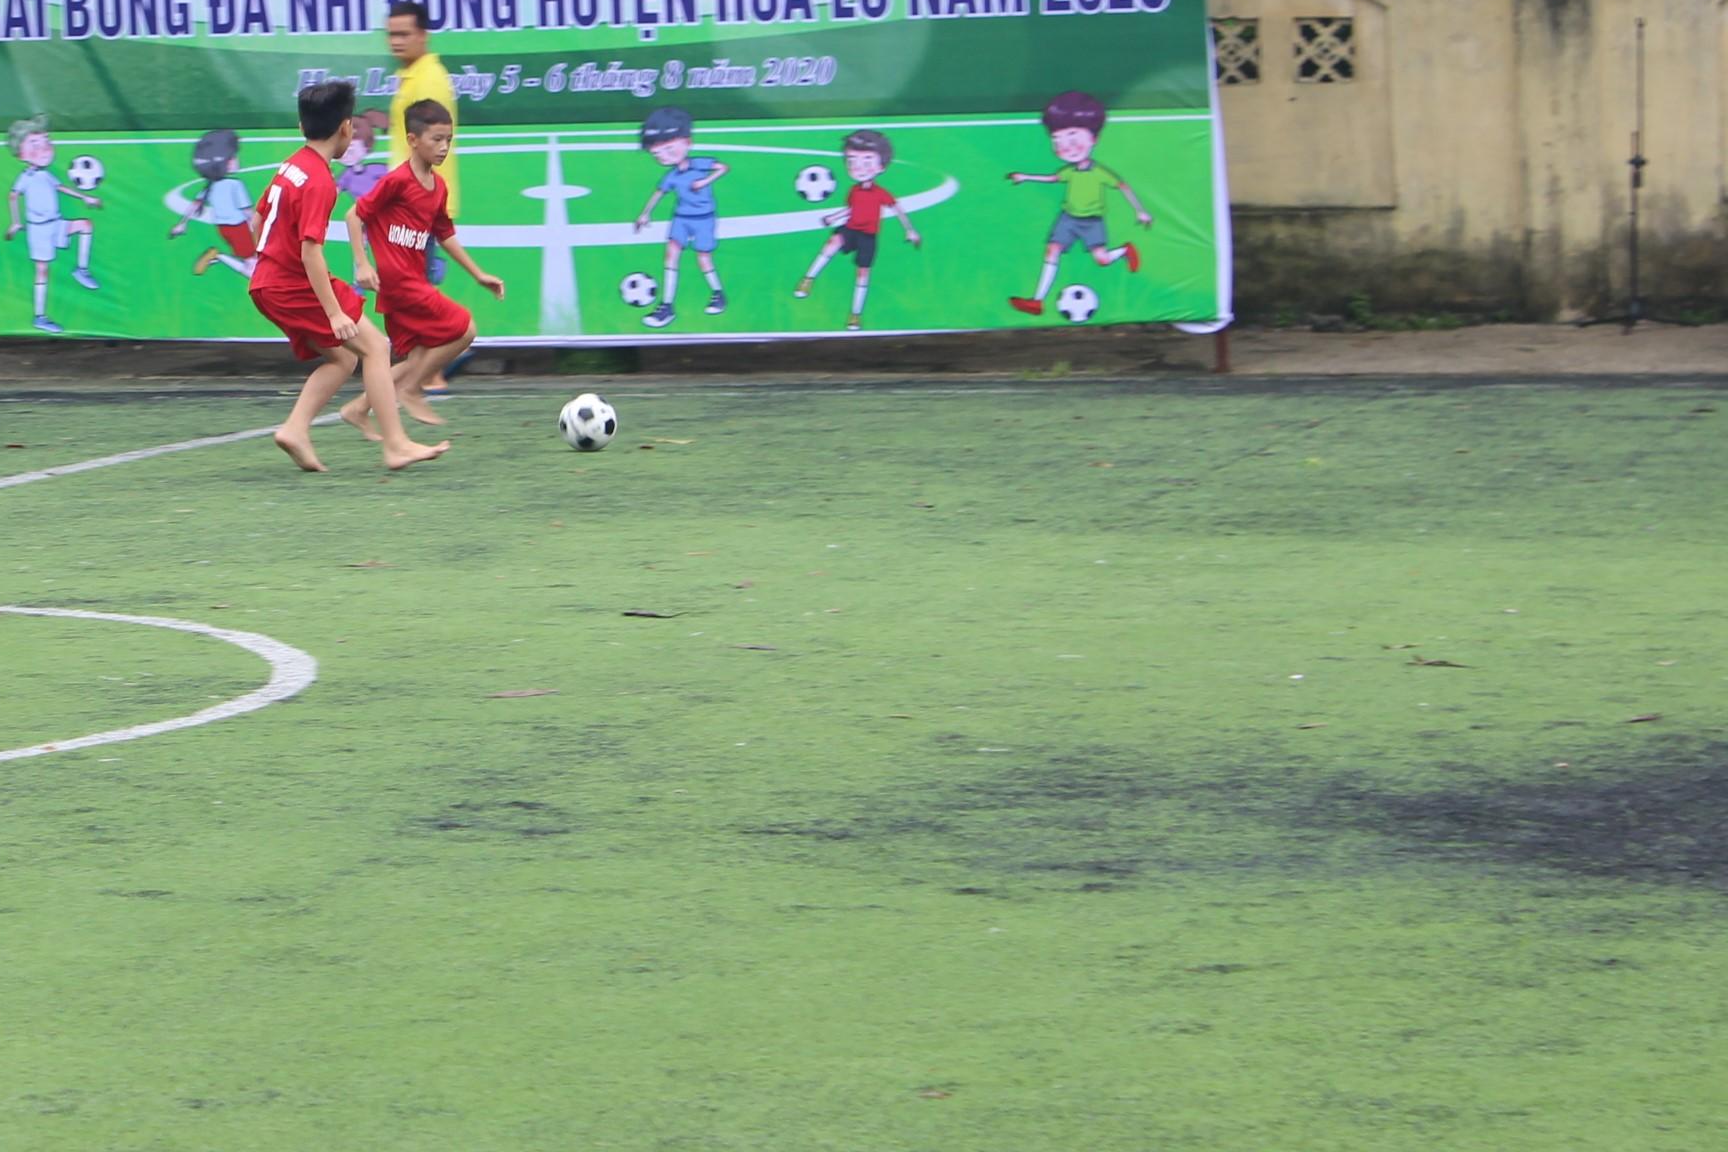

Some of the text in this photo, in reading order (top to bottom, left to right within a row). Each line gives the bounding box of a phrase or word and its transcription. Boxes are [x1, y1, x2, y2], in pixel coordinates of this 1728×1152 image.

[498, 64, 521, 94] 5
[543, 63, 569, 93] 6
[570, 60, 659, 98] tháng
[661, 59, 684, 90] 8
[687, 57, 757, 89] năm
[759, 55, 838, 87] 2020
